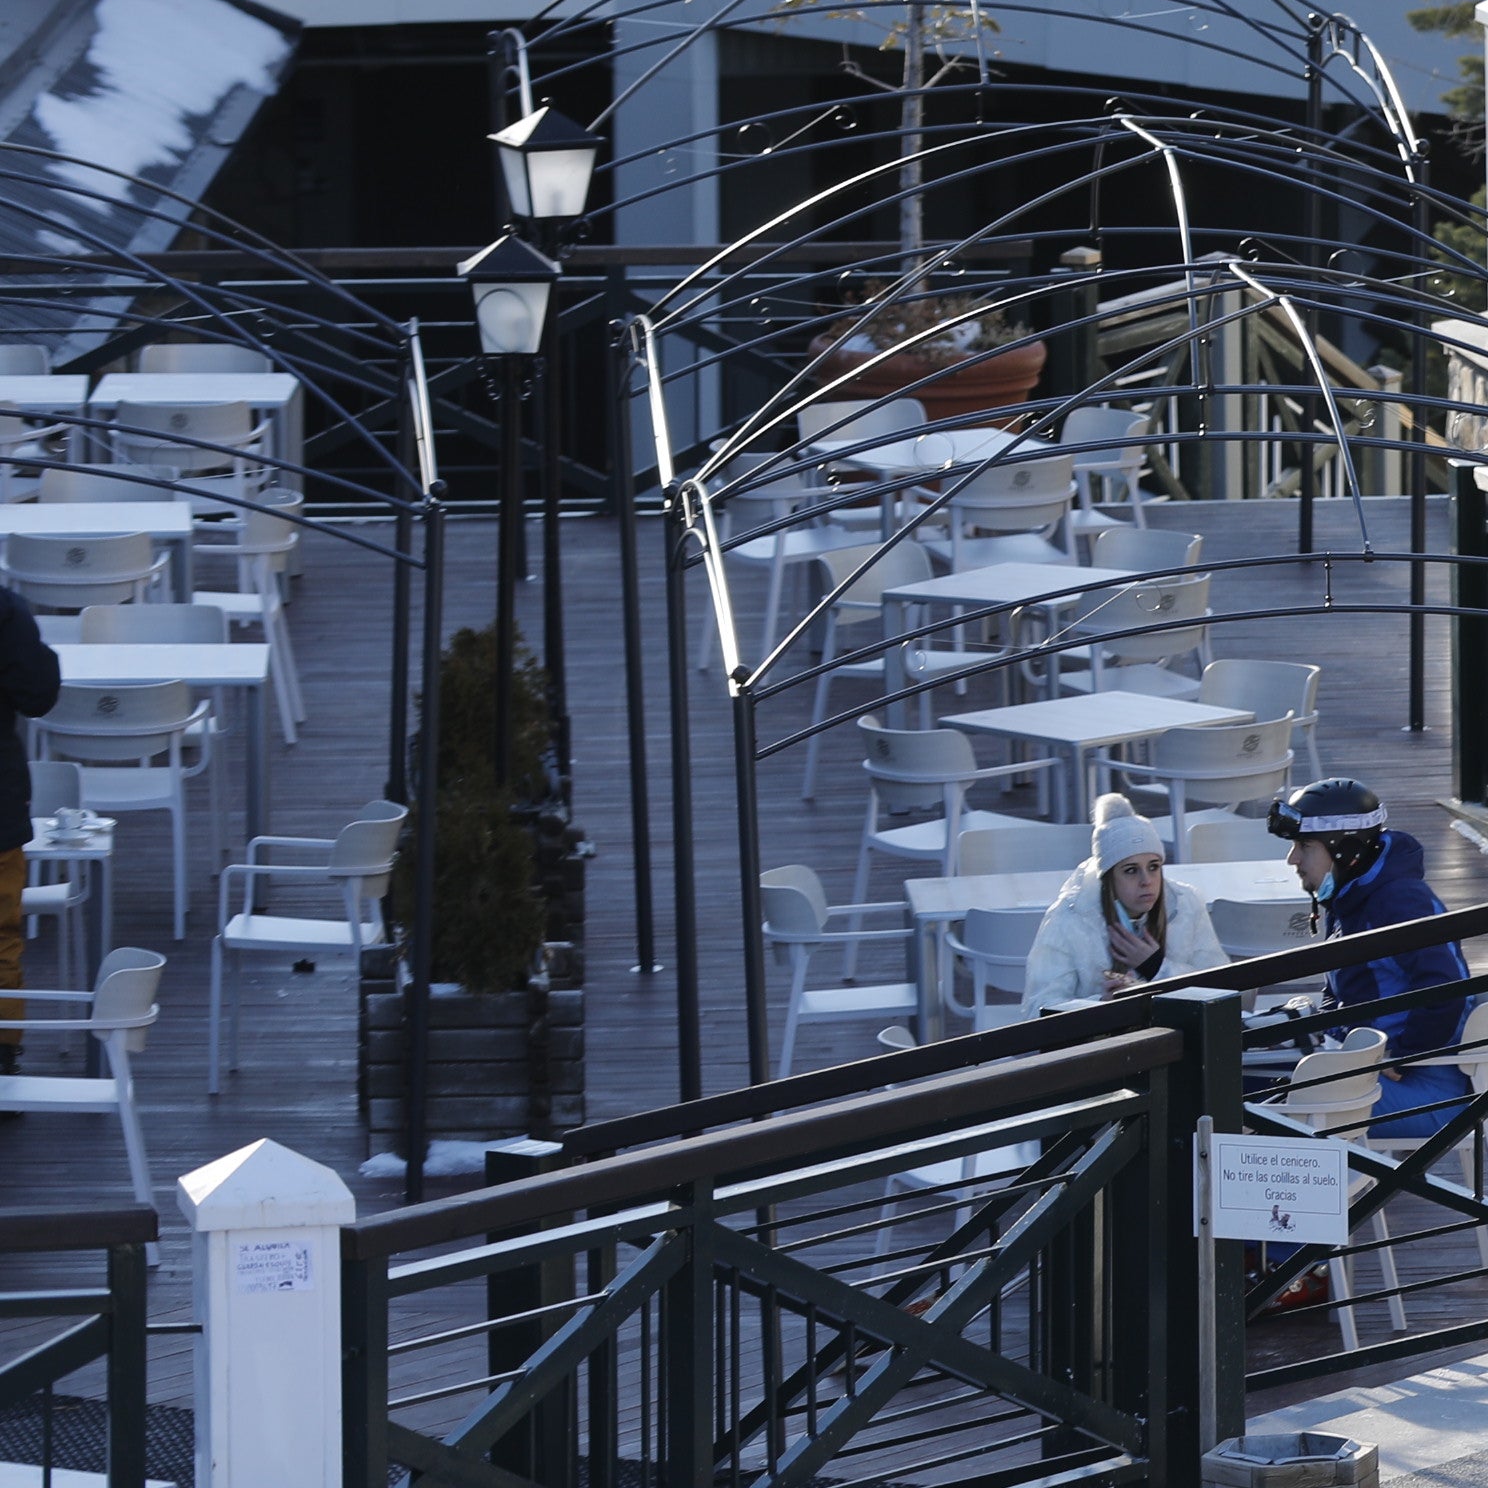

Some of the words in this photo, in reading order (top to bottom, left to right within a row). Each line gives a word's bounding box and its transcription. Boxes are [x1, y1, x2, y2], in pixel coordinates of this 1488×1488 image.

[1240, 1152, 1268, 1165] Utilice
[1270, 1154, 1279, 1165] el
[1280, 1156, 1321, 1168] cenicero.
[1223, 1169, 1236, 1181] No
[1238, 1170, 1254, 1182] tire
[1256, 1170, 1268, 1183] las
[1270, 1172, 1300, 1185] colillas
[1302, 1173, 1310, 1185] al
[1312, 1174, 1339, 1186] suelo.
[1264, 1187, 1297, 1201] Gracias
